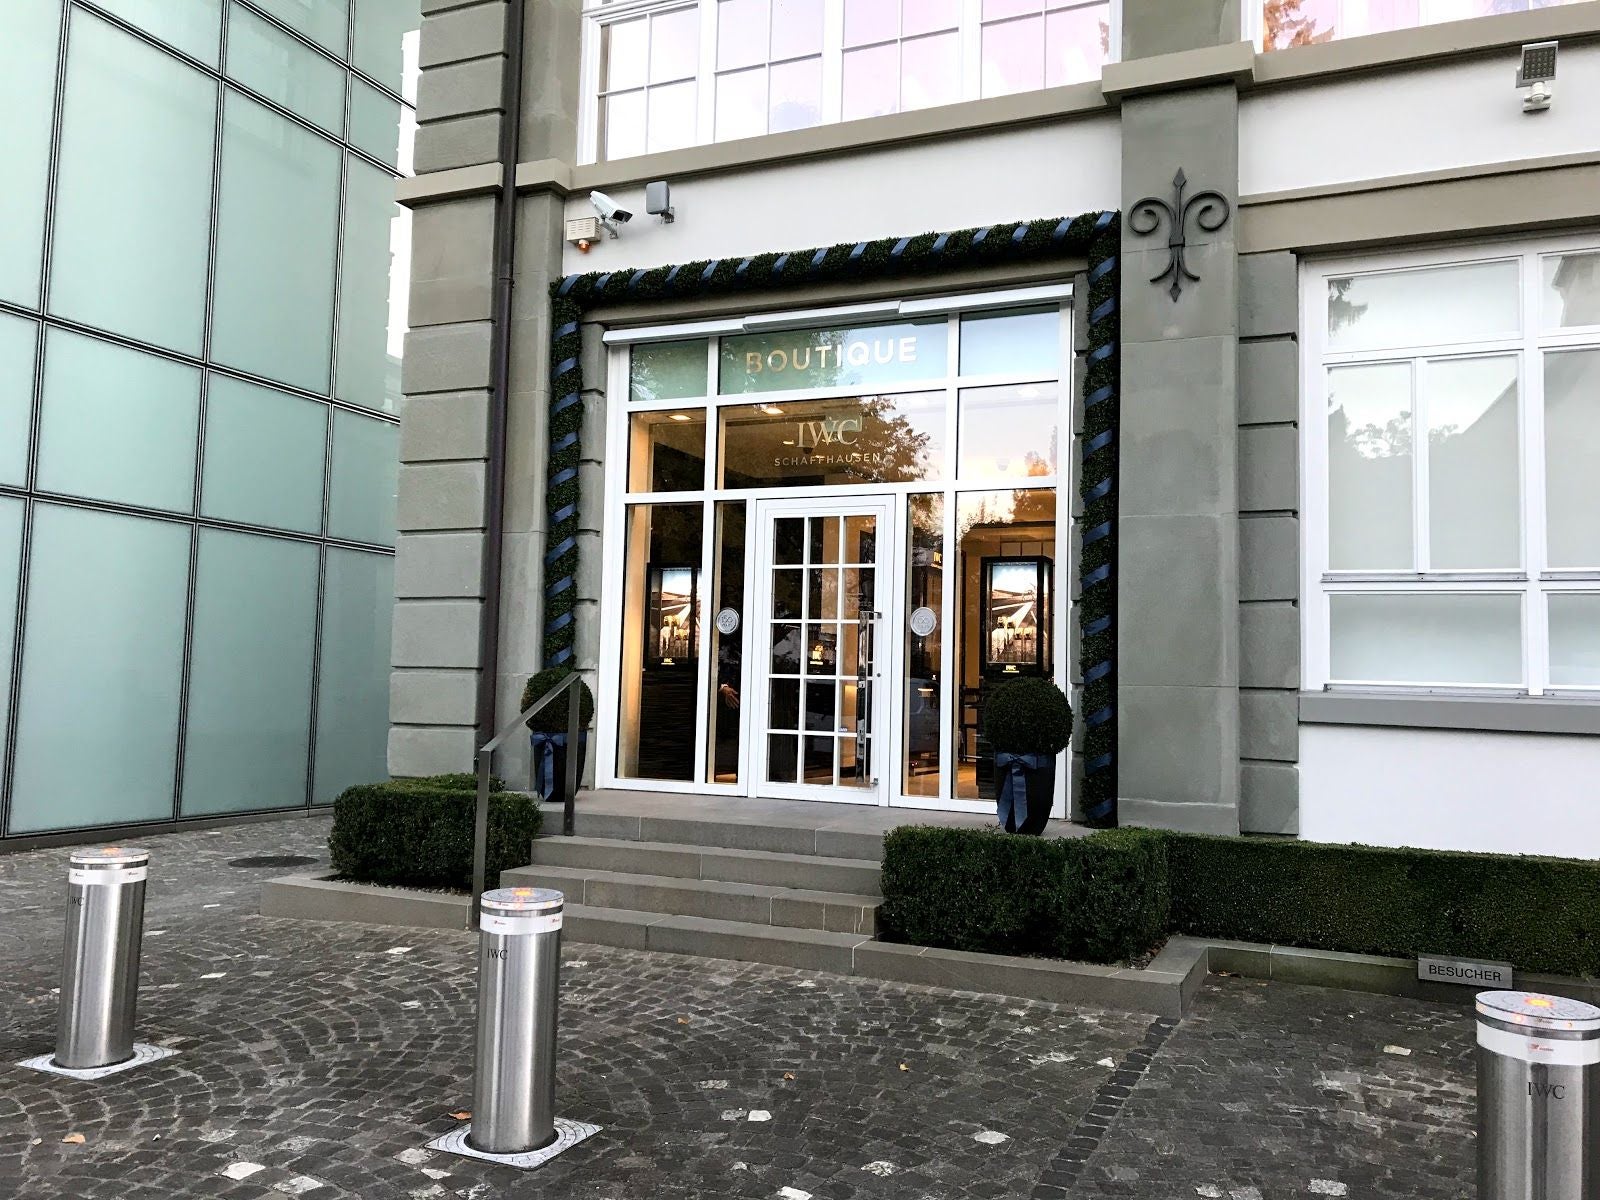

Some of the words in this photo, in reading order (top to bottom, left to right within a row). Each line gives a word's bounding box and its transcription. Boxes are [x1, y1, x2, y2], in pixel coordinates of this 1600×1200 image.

[746, 336, 917, 374] BOUTIQUE
[796, 418, 859, 449] IWC
[774, 452, 881, 467] SCHAFFHAUSEN
[69, 896, 85, 907] IWC
[486, 948, 508, 961] IWC
[1428, 964, 1502, 982] BESUCHER
[1528, 1081, 1566, 1100] IWC
